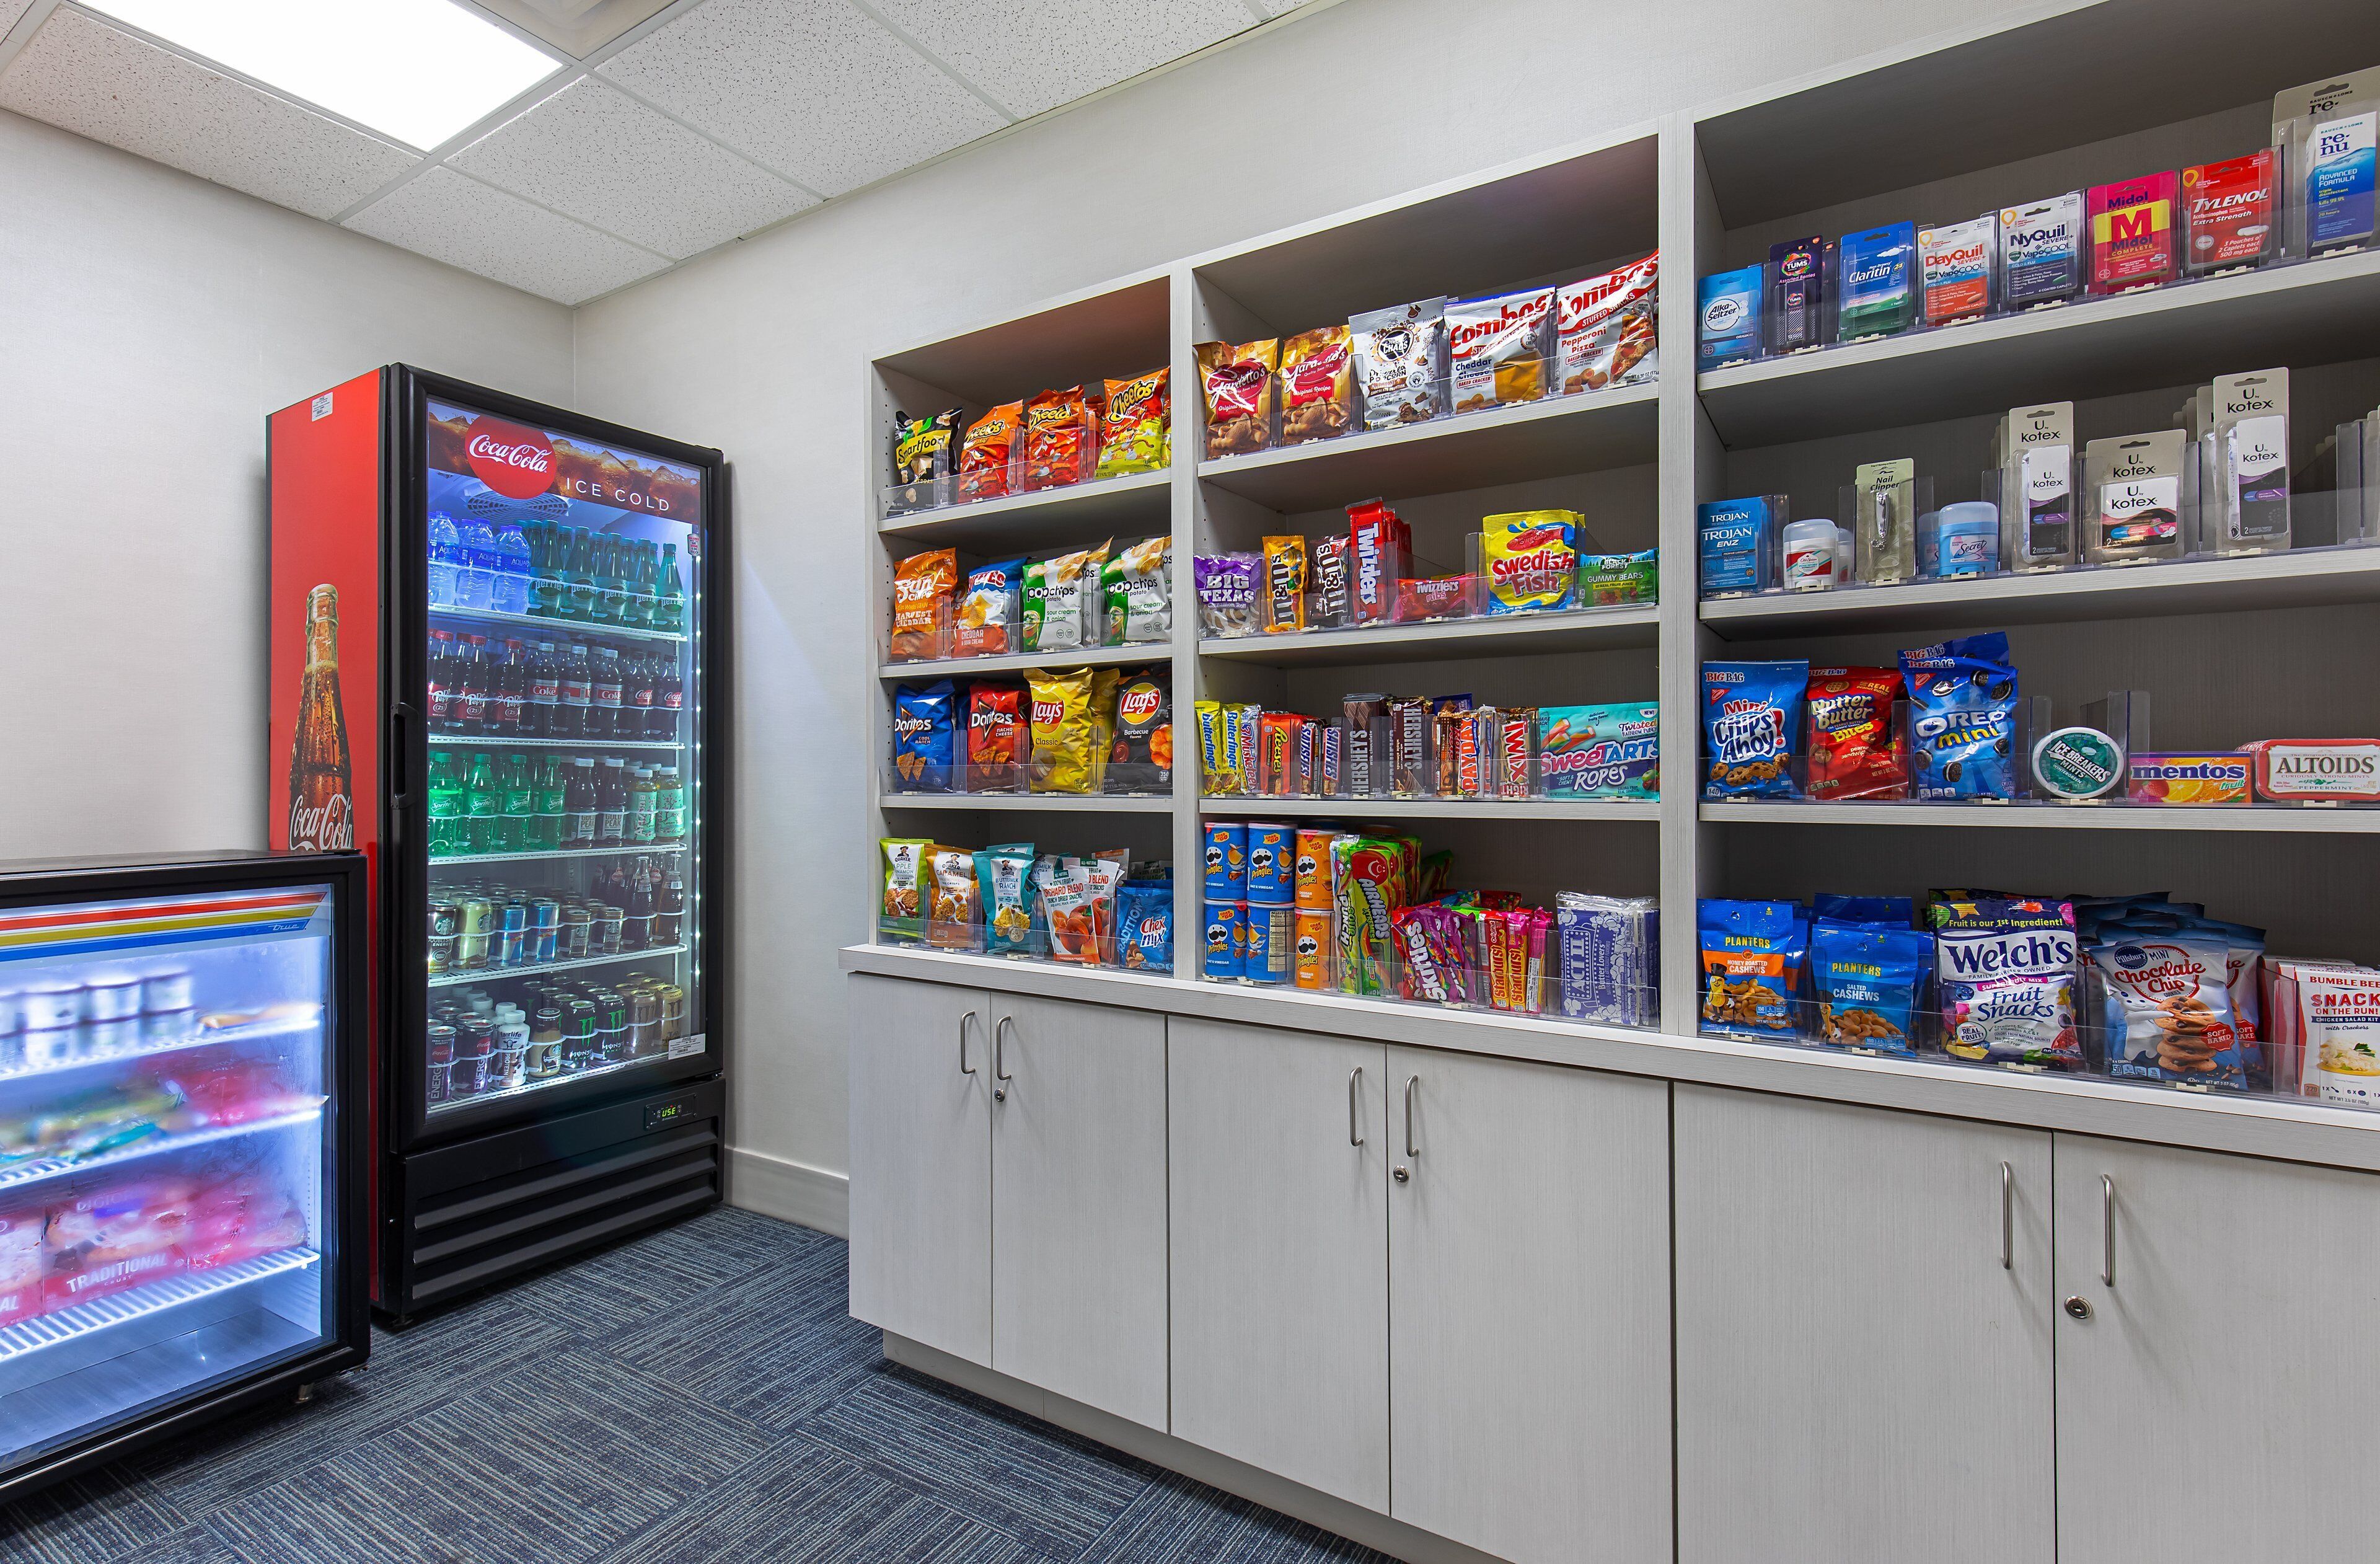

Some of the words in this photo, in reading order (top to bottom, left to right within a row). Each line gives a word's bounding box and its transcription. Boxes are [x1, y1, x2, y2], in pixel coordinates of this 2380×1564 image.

[2109, 192, 2148, 208] Midol
[2319, 188, 2348, 197] disinfectant
[2193, 188, 2268, 213] TYLENOL
[2193, 218, 2213, 226] Extra
[2215, 211, 2252, 223] Strength
[2011, 224, 2065, 247] NyQuil
[2042, 236, 2068, 245] SEVERE
[2112, 234, 2153, 251] Midol
[1926, 244, 1983, 268] DayQuil
[2023, 242, 2071, 258] VapoCOOL
[2112, 244, 2153, 256] COMPLETE
[1786, 260, 1807, 270] TUMS
[1957, 257, 1981, 265] SEVERE
[1779, 276, 1799, 284] Assorted
[1800, 272, 1815, 280] Berries
[1849, 266, 1890, 284] Claritin
[1939, 263, 1984, 278] VapoCOOL
[1708, 307, 1737, 321] Seltzer
[1711, 303, 1732, 314] Alka-
[1562, 326, 1606, 348] Pepperoni
[1572, 342, 1595, 353] Pizza
[1567, 355, 1580, 364] BAKED
[1581, 349, 1602, 359] CRACKER
[1456, 358, 1492, 371] Cheddar
[1473, 376, 1491, 384] CRACKER
[1108, 379, 1155, 424] Cheetos
[469, 434, 555, 473] Coca-Cola
[897, 435, 946, 464] Smartfood
[1871, 482, 1900, 491] Clipper
[1876, 475, 1893, 484] Nail
[566, 477, 602, 498] ICE
[615, 488, 670, 511] COLD
[1711, 513, 1749, 523] TROJAN
[1703, 526, 1753, 540] TROJAN
[1716, 539, 1739, 547] ENZ
[1492, 550, 1575, 583] Swedish
[1206, 575, 1250, 590] BIG
[1510, 572, 1560, 597] Fish
[1587, 573, 1616, 583] GUMMY
[1619, 572, 1644, 581] BEARS
[1200, 588, 1254, 603] TEXAS
[896, 611, 932, 621] HARVEST
[961, 630, 984, 639] CHEDDAR
[1932, 659, 1954, 668] BAG
[1705, 673, 1724, 682] BIG
[1726, 673, 1744, 682] BAG
[532, 686, 556, 696] Coke
[1867, 682, 1890, 692] REAL
[1122, 688, 1160, 714] Lay's
[1724, 700, 1766, 716] Mini
[1812, 695, 1872, 715] Nutter
[971, 712, 1013, 728] Doritos
[1033, 701, 1064, 724] Lay's
[1818, 707, 1874, 730] Butter
[895, 717, 932, 732] Doritos
[1619, 719, 1657, 733] Twisted
[1714, 714, 1772, 744] Chips
[1916, 712, 2006, 738] OREO
[1035, 737, 1058, 746] Classic
[1202, 713, 1216, 772] Butterfinger
[1227, 712, 1238, 771] Butterfinger
[1404, 707, 1422, 770] HERSHEY'S
[1937, 727, 1998, 749] mini
[1350, 730, 1369, 793] HERSHEY'S
[1461, 718, 1478, 792] PAYDAY
[2060, 760, 2086, 777] MINTS
[2132, 764, 2245, 780] mentos
[2276, 756, 2374, 774] ALTOIDS
[2053, 764, 2082, 784] WINTERGREEN
[2219, 779, 2245, 791] fruit
[431, 799, 452, 810] Sprite
[289, 793, 353, 852] Coca-Cola
[937, 870, 967, 878] CARAMEL
[1251, 868, 1272, 880] Pringles
[1044, 886, 1066, 897] ORCHARD
[1067, 883, 1083, 893] BLEND
[1298, 877, 1316, 888] Pringles
[1359, 878, 1389, 939] AIRHEADS
[1141, 916, 1166, 934] Chex
[2011, 918, 2063, 928] Ingredient!
[1208, 942, 1228, 955] Pringles
[1725, 936, 1770, 948] PLANTERS
[1944, 935, 2074, 973] Welch's
[2115, 952, 2147, 964] Pillsbury
[2149, 950, 2169, 960] MINI
[1297, 955, 1318, 970] Pringles
[1729, 965, 1766, 974] CASHEWS
[1832, 963, 1882, 977] PLANTERS
[1490, 944, 1505, 998] Starburst
[1508, 948, 1523, 1002] Starburst
[2115, 960, 2206, 984] Chocolate
[2148, 978, 2185, 993] Chip
[1833, 989, 1880, 1002] CASHEWS
[1991, 986, 2044, 1006] Fruit
[1977, 1002, 2054, 1022] Snacks
[1962, 1027, 1980, 1035] REAL
[1962, 1032, 1984, 1041] FRUIT!
[2207, 1029, 2226, 1038] SOFT
[2207, 1035, 2231, 1044] BAKED
[662, 1107, 676, 1117] USE
[66, 1252, 167, 1294] TRADITIONAL
[104, 1275, 133, 1287] CRUST
